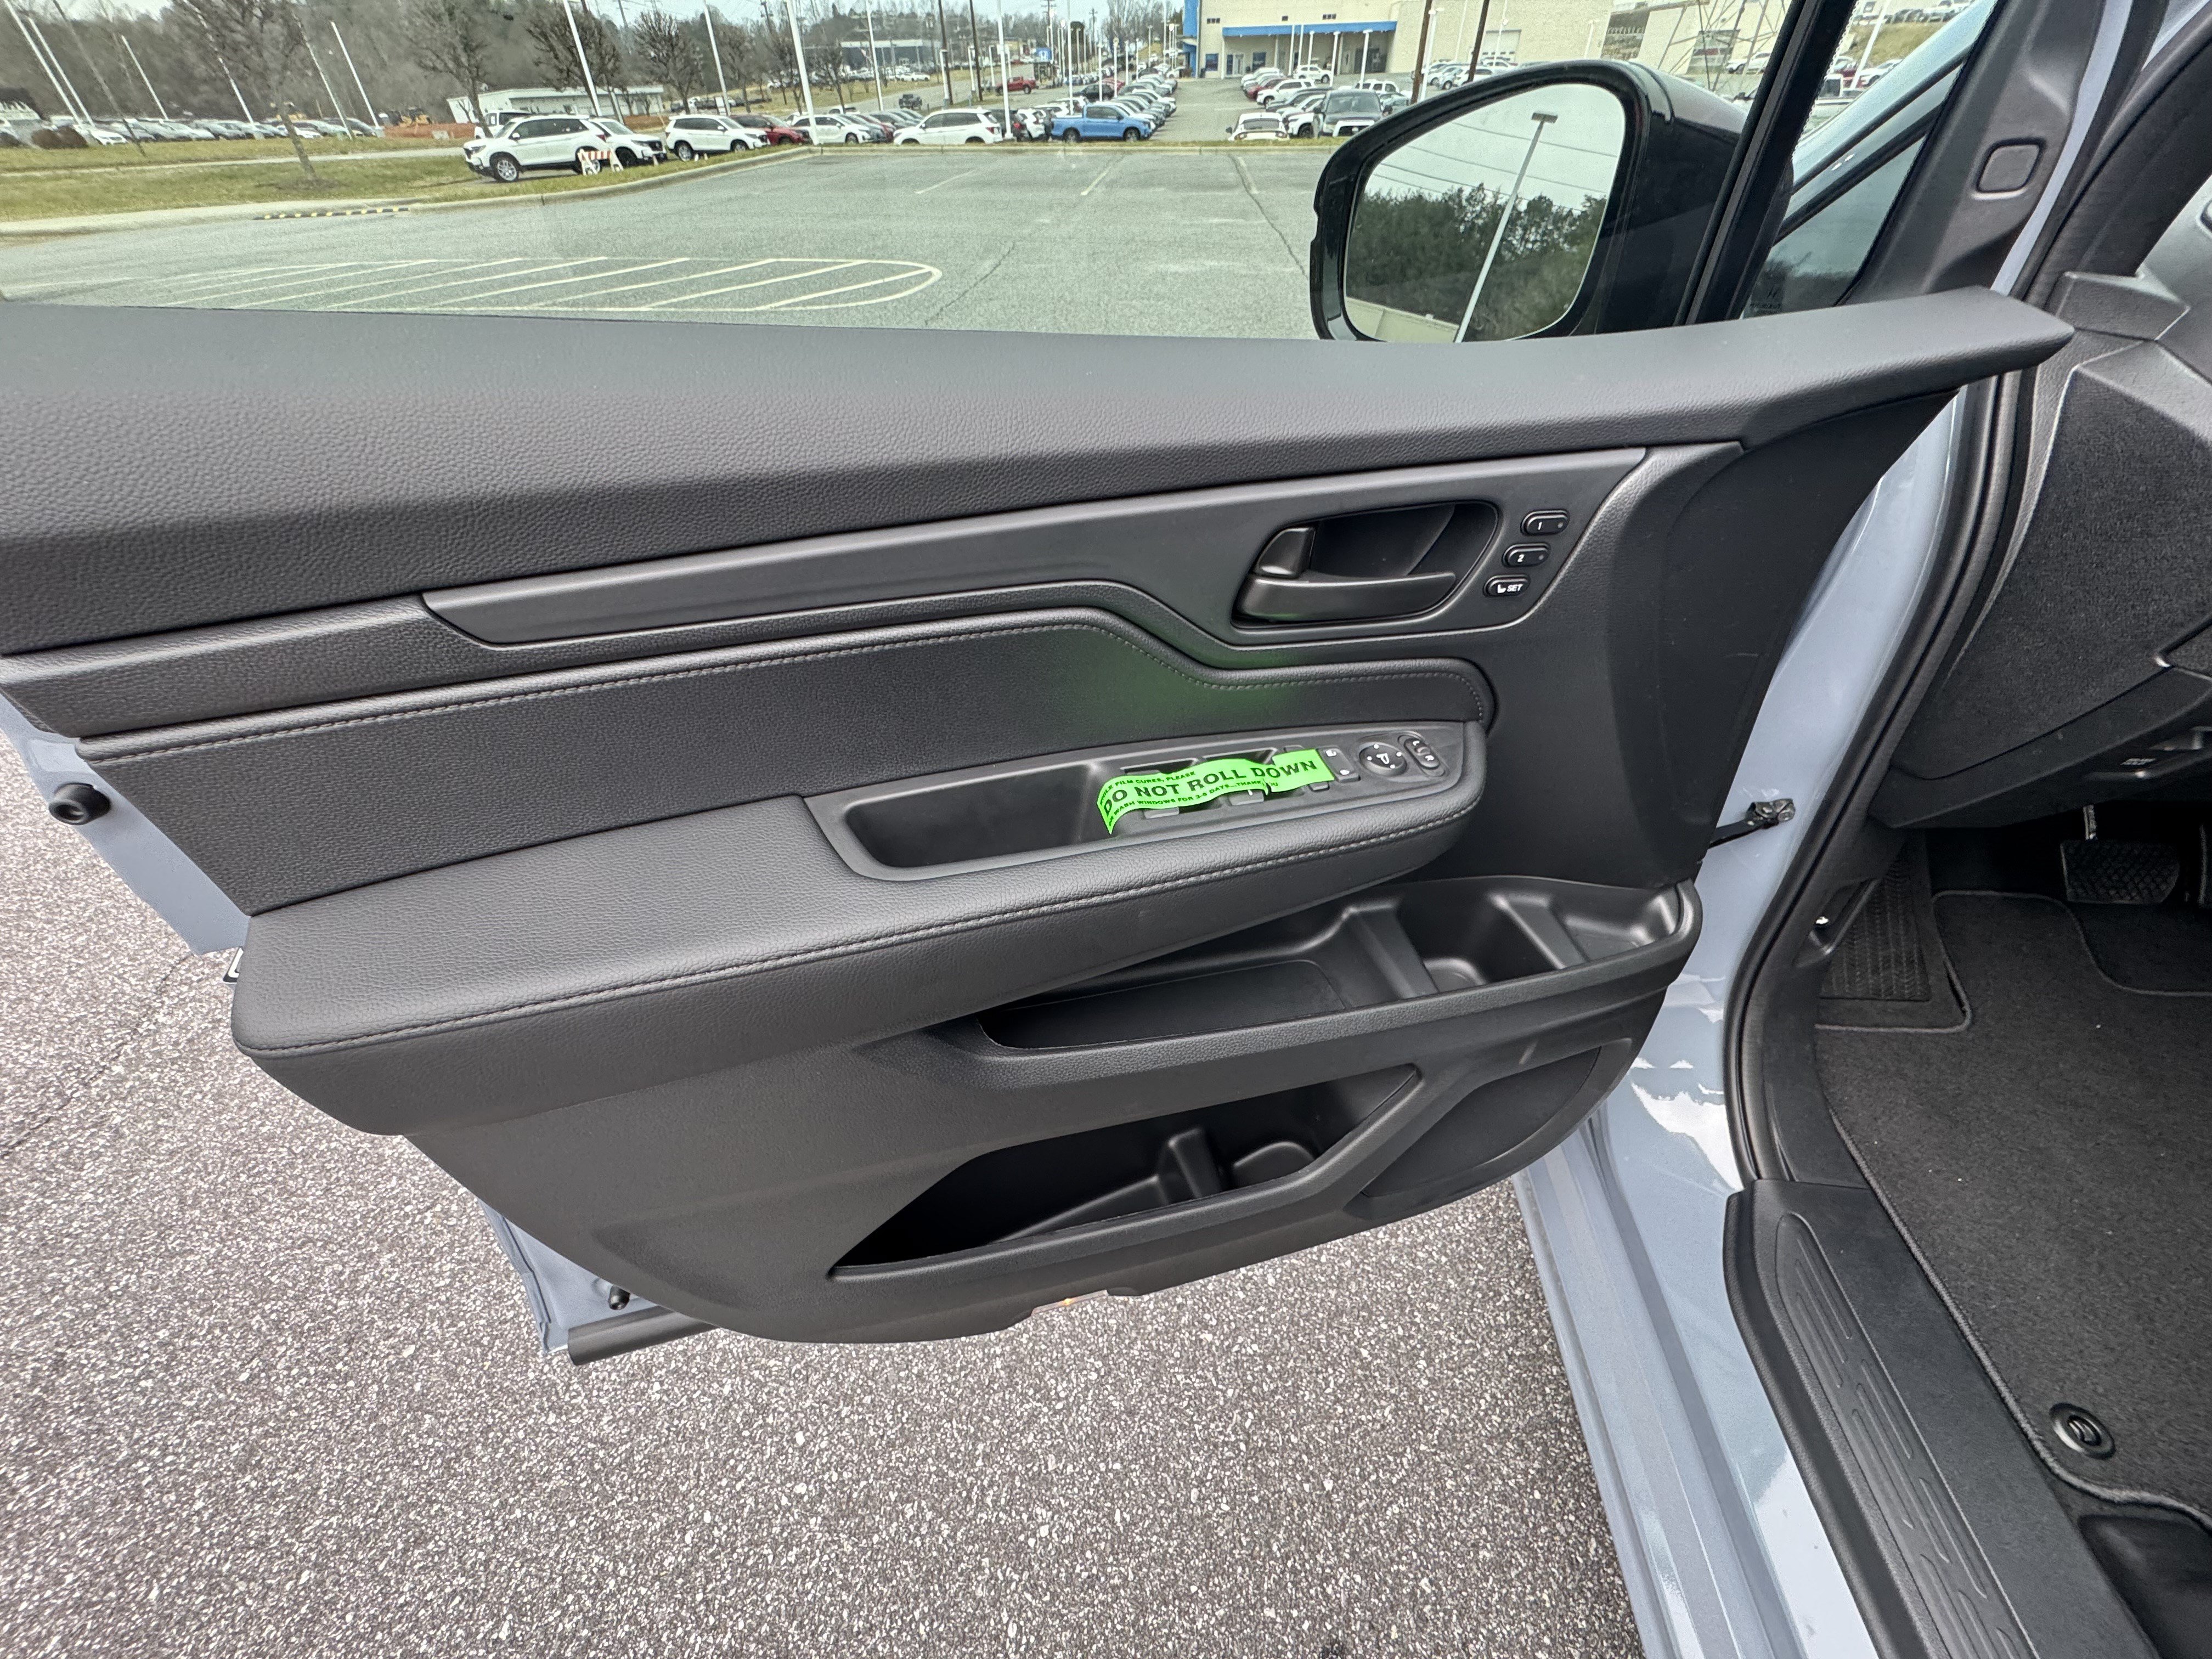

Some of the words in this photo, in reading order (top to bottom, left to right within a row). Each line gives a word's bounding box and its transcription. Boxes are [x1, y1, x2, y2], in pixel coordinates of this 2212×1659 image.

[1538, 522, 1543, 530] 1
[1517, 554, 1525, 562] 2
[1506, 584, 1523, 592] SET
[1166, 771, 1196, 781] PLEASE
[1104, 789, 1128, 817] DO
[1134, 784, 1179, 797] NOT
[1187, 769, 1246, 792] ROLL
[1250, 760, 1317, 778] DOWN
[1114, 800, 1135, 815] WASH
